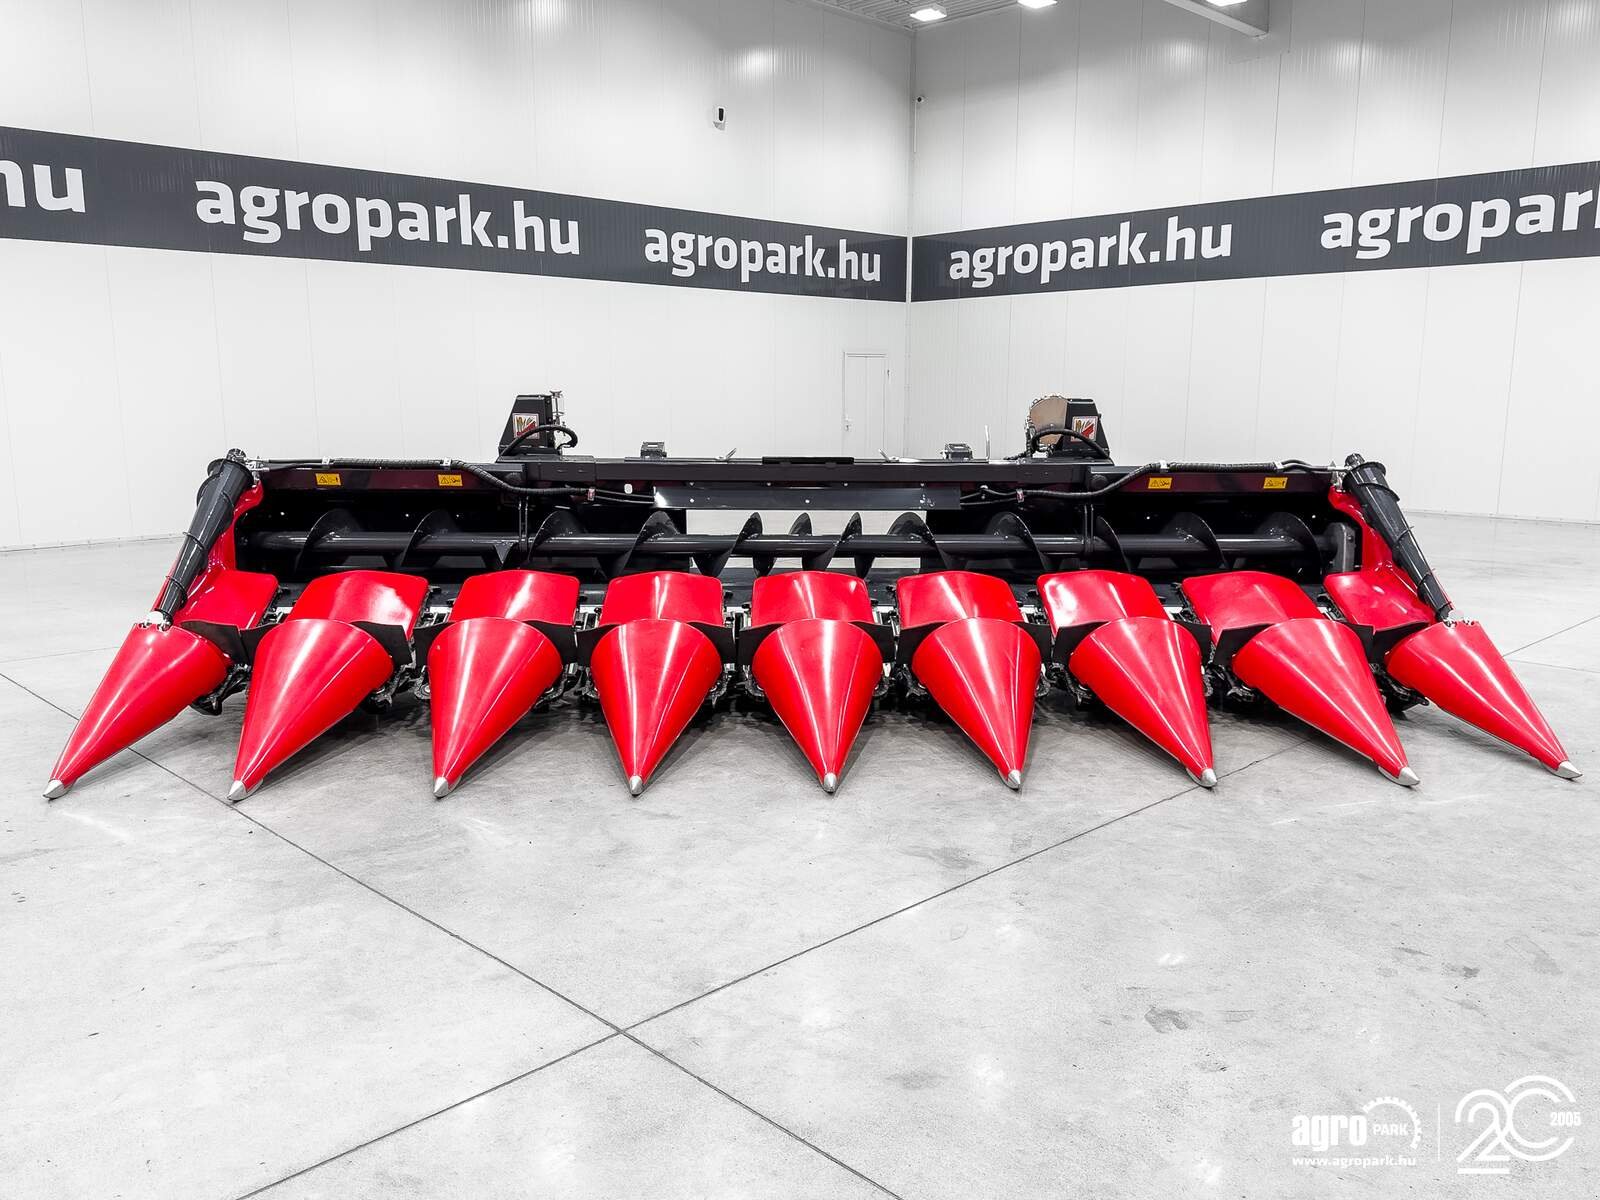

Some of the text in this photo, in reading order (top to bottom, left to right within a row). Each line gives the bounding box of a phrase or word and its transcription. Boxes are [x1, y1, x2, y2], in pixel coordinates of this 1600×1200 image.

[195, 180, 580, 252] agropark.hu
[949, 216, 1232, 288] agropark.hu
[1320, 184, 1600, 259] agropar
[644, 228, 881, 283] agropark.hu
